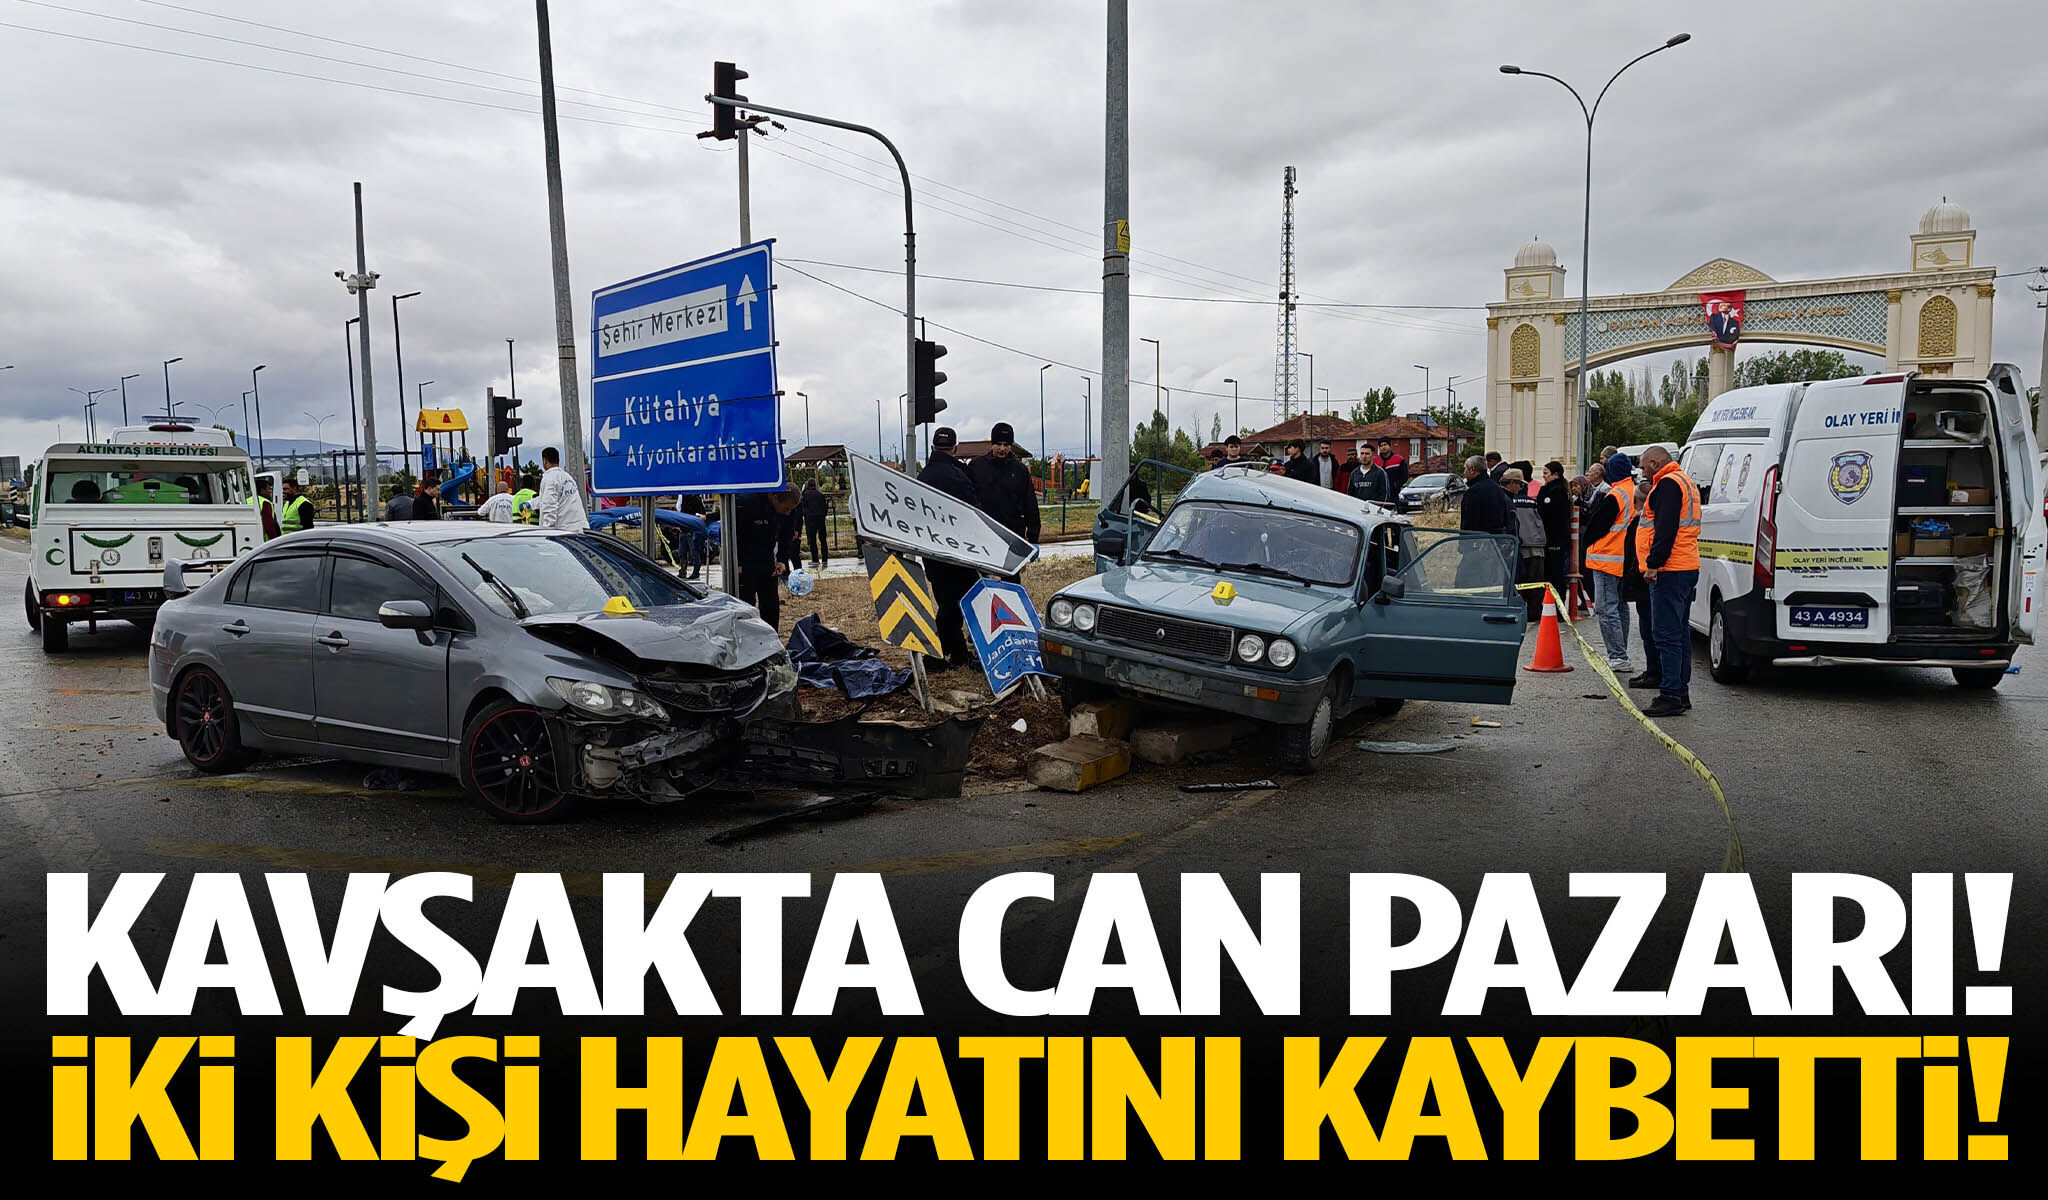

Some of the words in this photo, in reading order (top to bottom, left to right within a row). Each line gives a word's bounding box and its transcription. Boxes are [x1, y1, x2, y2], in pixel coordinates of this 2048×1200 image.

[603, 320, 643, 349] Şehir
[652, 300, 723, 336] Merkezi
[625, 390, 720, 426] Kütahya
[1824, 413, 1857, 428] OLAY
[1860, 408, 1889, 425] YERİ
[77, 445, 141, 457] ALTINTAŞ
[145, 446, 218, 457] BELEDİYESİ
[626, 437, 769, 471] Afyonkarahisar
[884, 481, 958, 526] Şehir
[1795, 610, 1811, 621] 43
[1814, 611, 1825, 621] A
[1828, 612, 1863, 622] 4934
[986, 635, 1039, 666] Jandarm
[1025, 654, 1044, 669] 11
